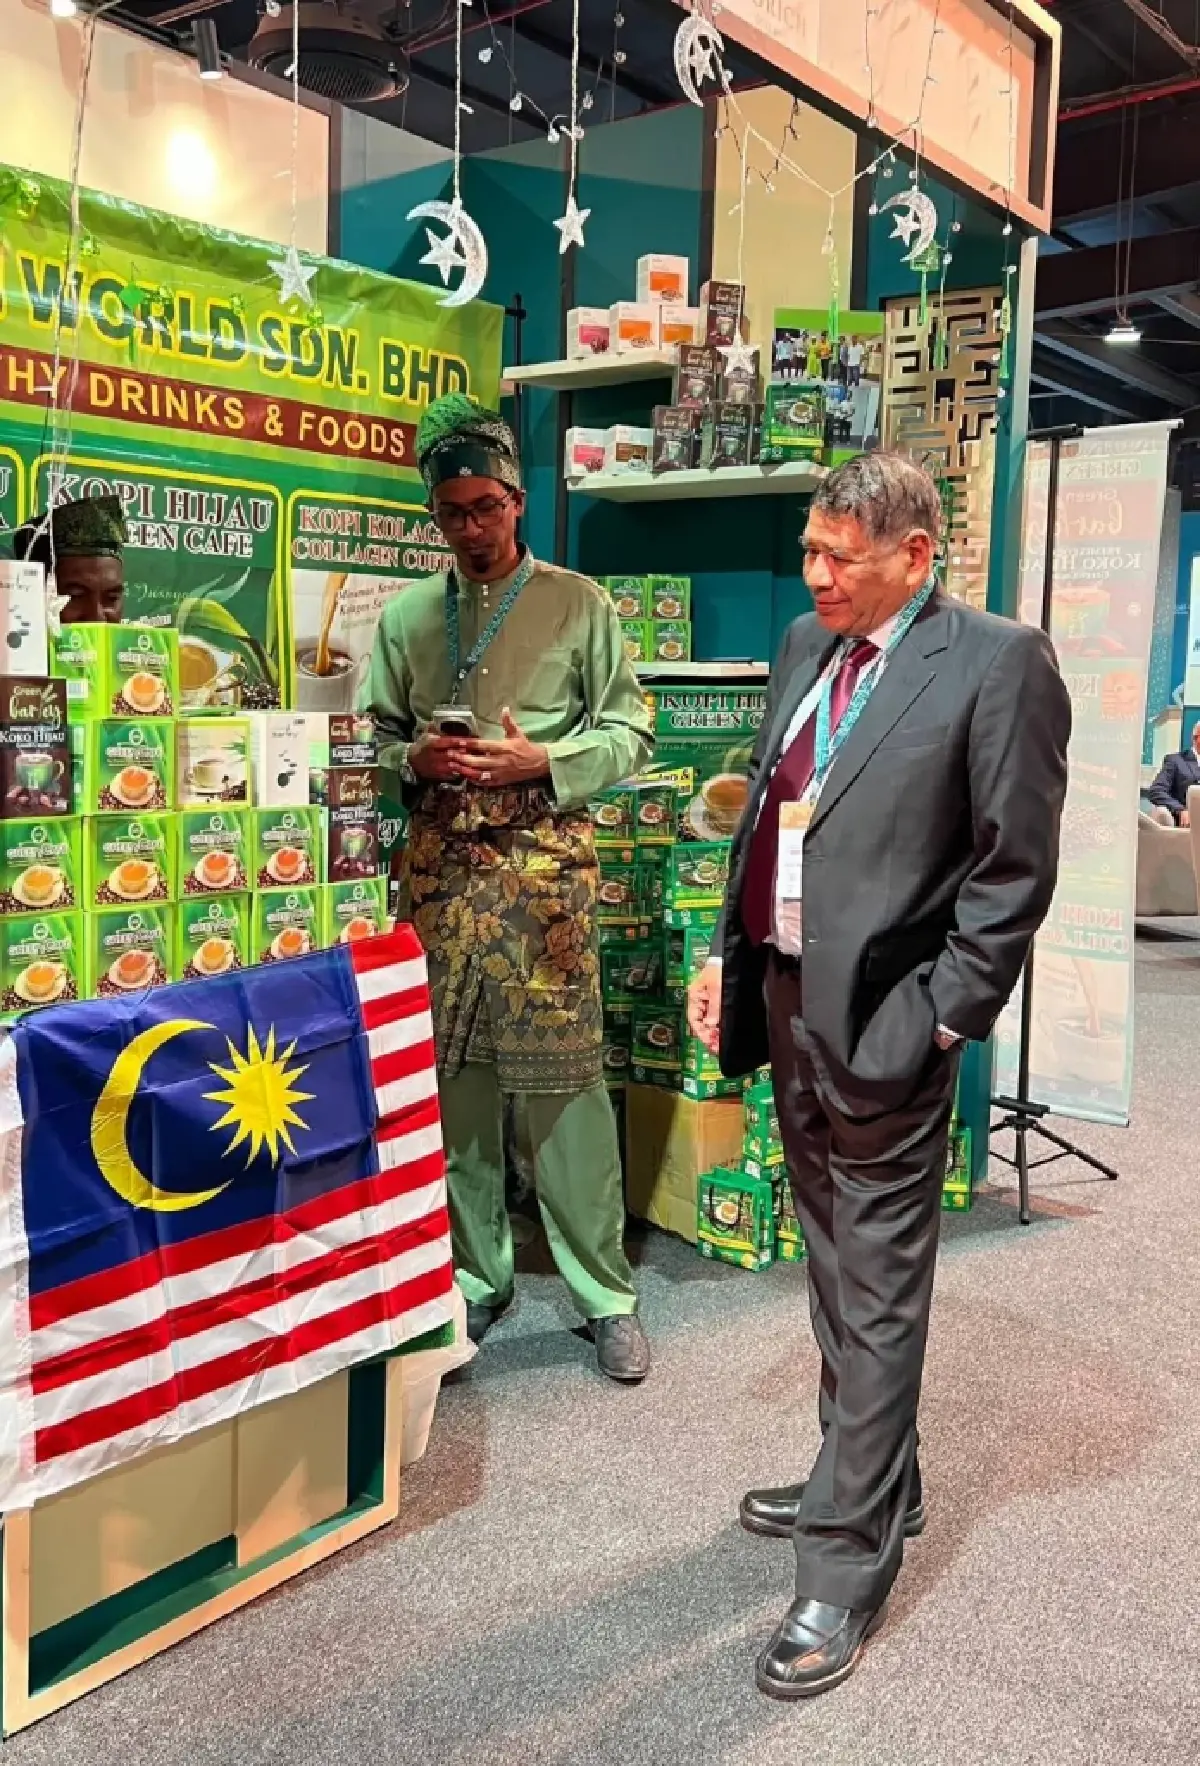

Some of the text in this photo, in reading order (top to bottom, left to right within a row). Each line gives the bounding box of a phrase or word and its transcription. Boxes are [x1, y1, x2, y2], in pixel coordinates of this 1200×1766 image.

[17, 251, 248, 368] WORLD
[257, 311, 369, 395] SDN.
[379, 336, 478, 407] BHD
[0, 355, 405, 458] HY DRINKS & FOODS
[46, 473, 155, 519] KOPI
[164, 486, 274, 532] HIJAU
[124, 520, 253, 558] EEN CAFE
[298, 505, 450, 547] KOPI KOLAG
[292, 536, 458, 573] COLLAGEN COFFE
[659, 691, 728, 711] KOPI
[670, 711, 743, 728] GREEN
